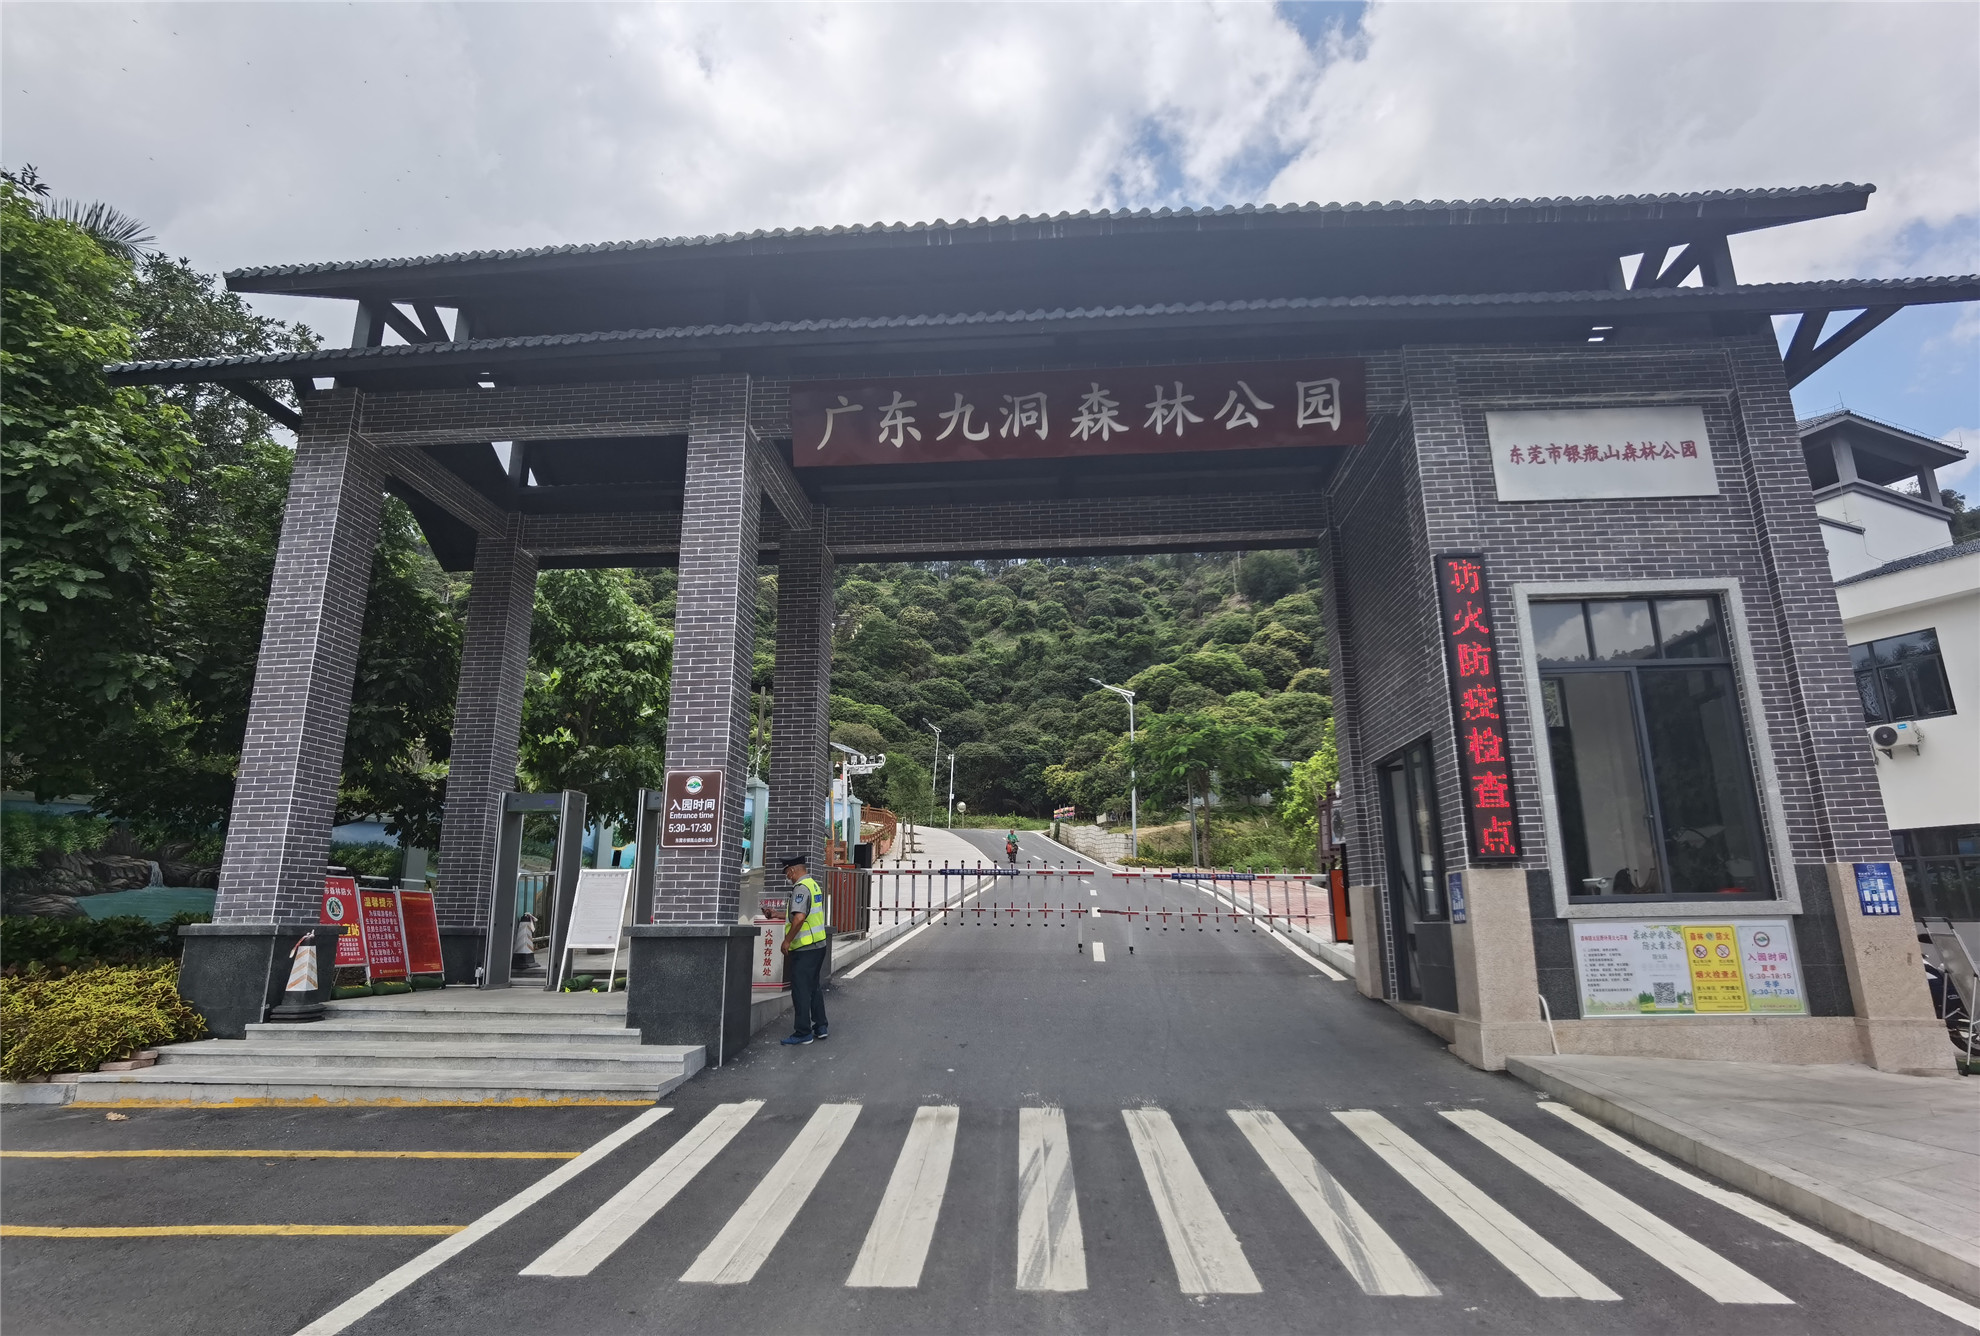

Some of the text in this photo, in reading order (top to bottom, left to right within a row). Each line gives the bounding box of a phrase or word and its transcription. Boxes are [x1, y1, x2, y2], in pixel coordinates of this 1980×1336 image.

[816, 377, 1342, 451] 广东九洞森林公园
[1509, 440, 1698, 465] 东莞市银瓶山森林公园
[1448, 559, 1516, 854] 防火防疫检查点
[670, 798, 716, 811] 入园时间
[699, 811, 714, 819] time
[364, 896, 394, 908] 温馨提示
[1633, 929, 1674, 940] 森林护我家
[1690, 932, 1730, 941] 森林 防火
[763, 929, 774, 977] 火种存放处
[1748, 952, 1788, 961] 入园时间
[1761, 964, 1776, 972] 夏季
[1764, 980, 1780, 988] 冬季
